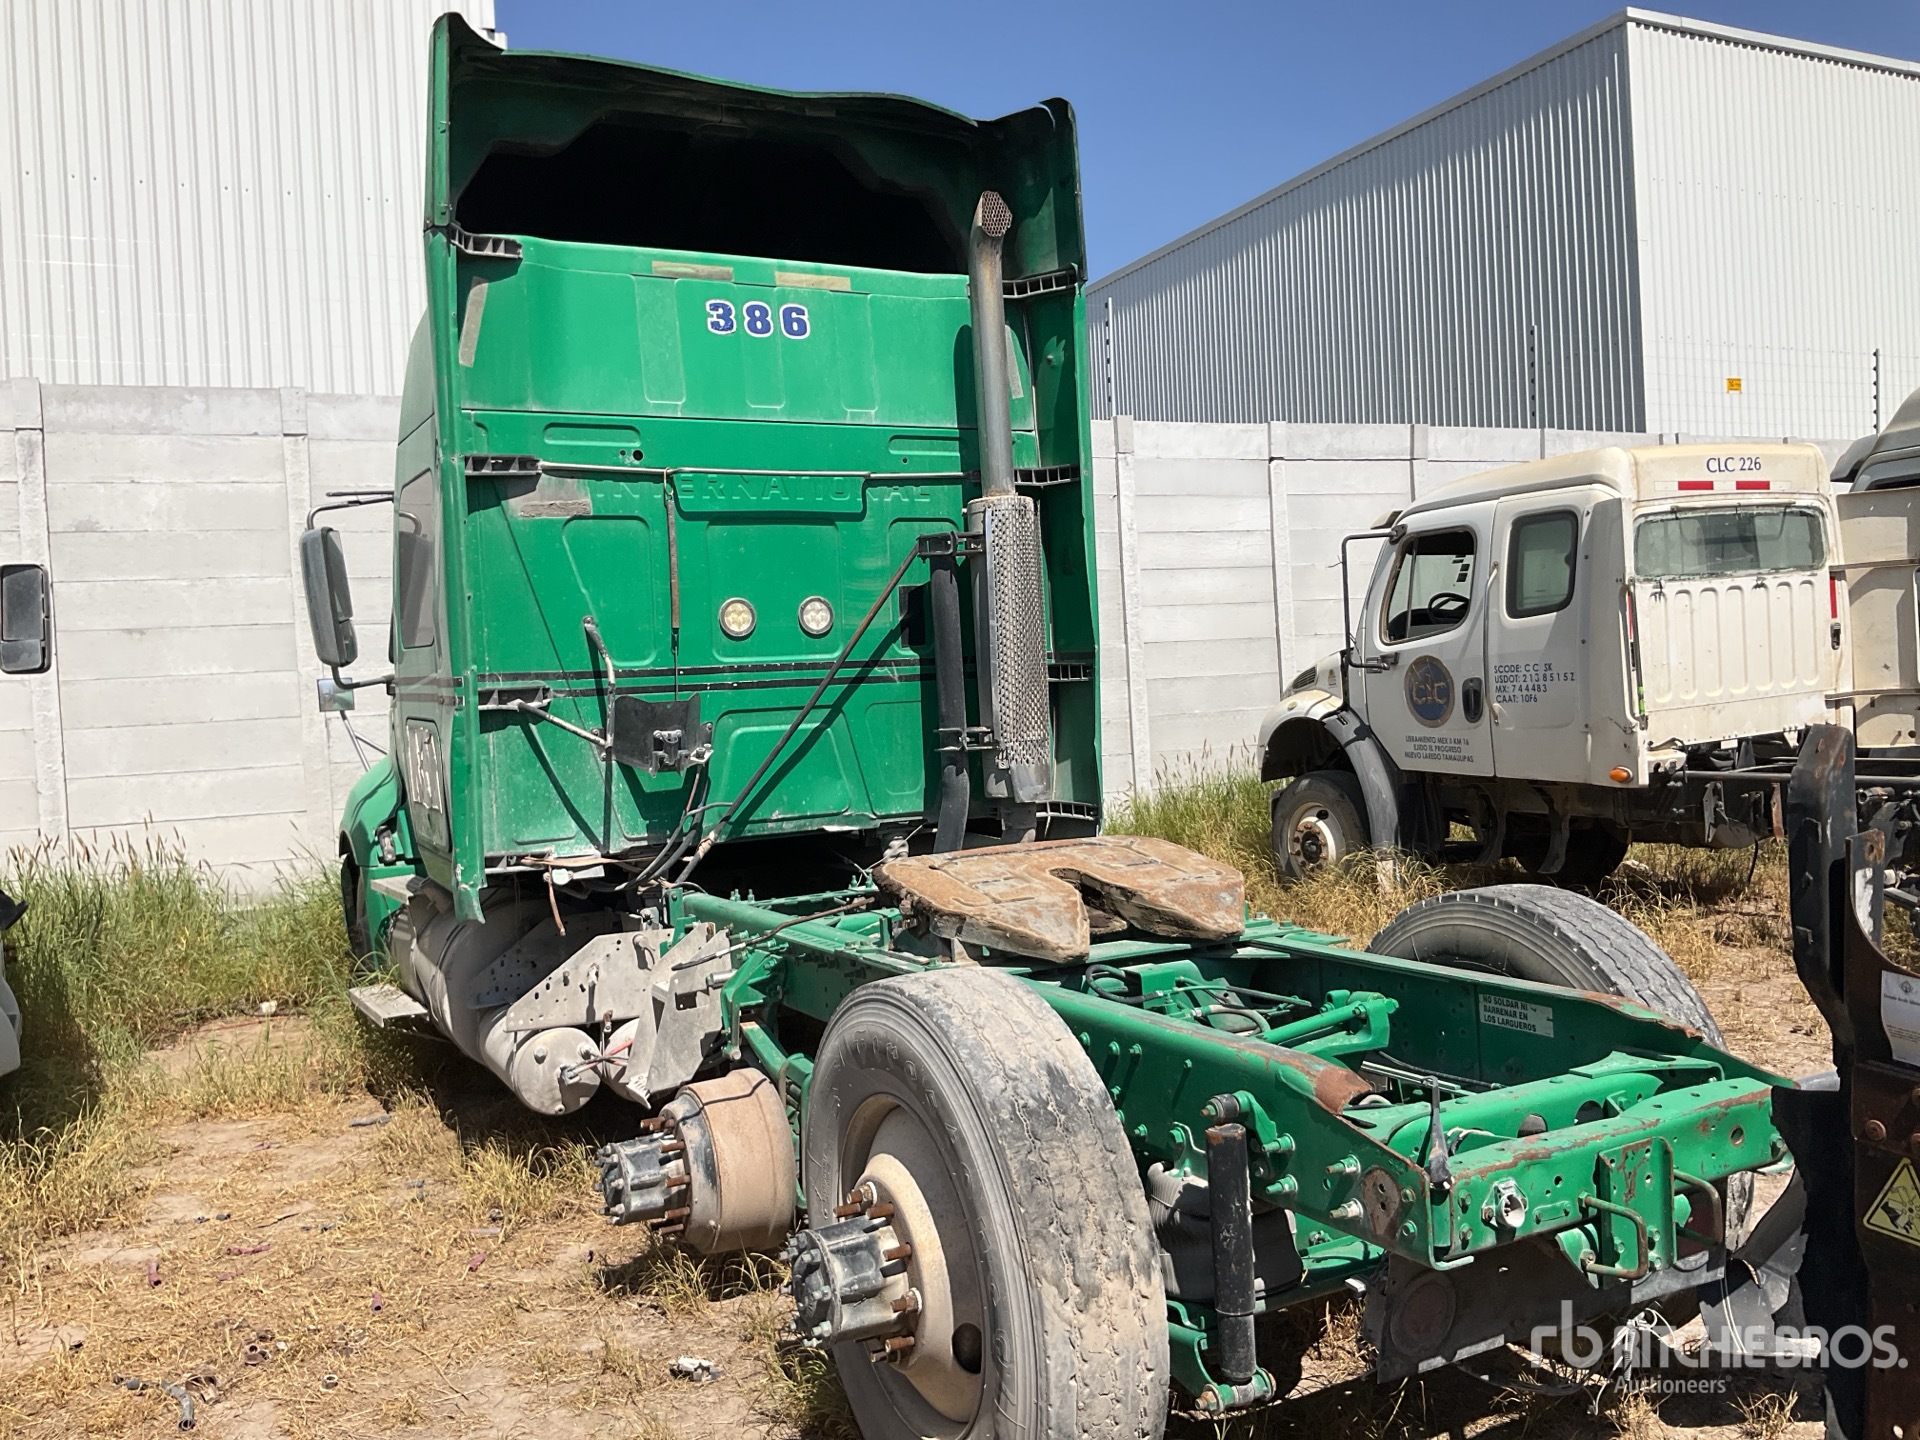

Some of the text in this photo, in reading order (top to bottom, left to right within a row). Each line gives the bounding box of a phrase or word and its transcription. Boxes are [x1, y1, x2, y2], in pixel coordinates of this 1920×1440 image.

[705, 299, 811, 340] 386
[1706, 456, 1761, 473] CLC 226
[1494, 664, 1521, 674] SCODE:
[1494, 674, 1520, 683] USDOT:
[1496, 694, 1518, 703] CAAT:
[1482, 994, 1528, 1011] NO SOLDAR NI
[1483, 1004, 1529, 1021] BARRENAR EN
[1483, 1014, 1537, 1032] LOS LARGUEROS
